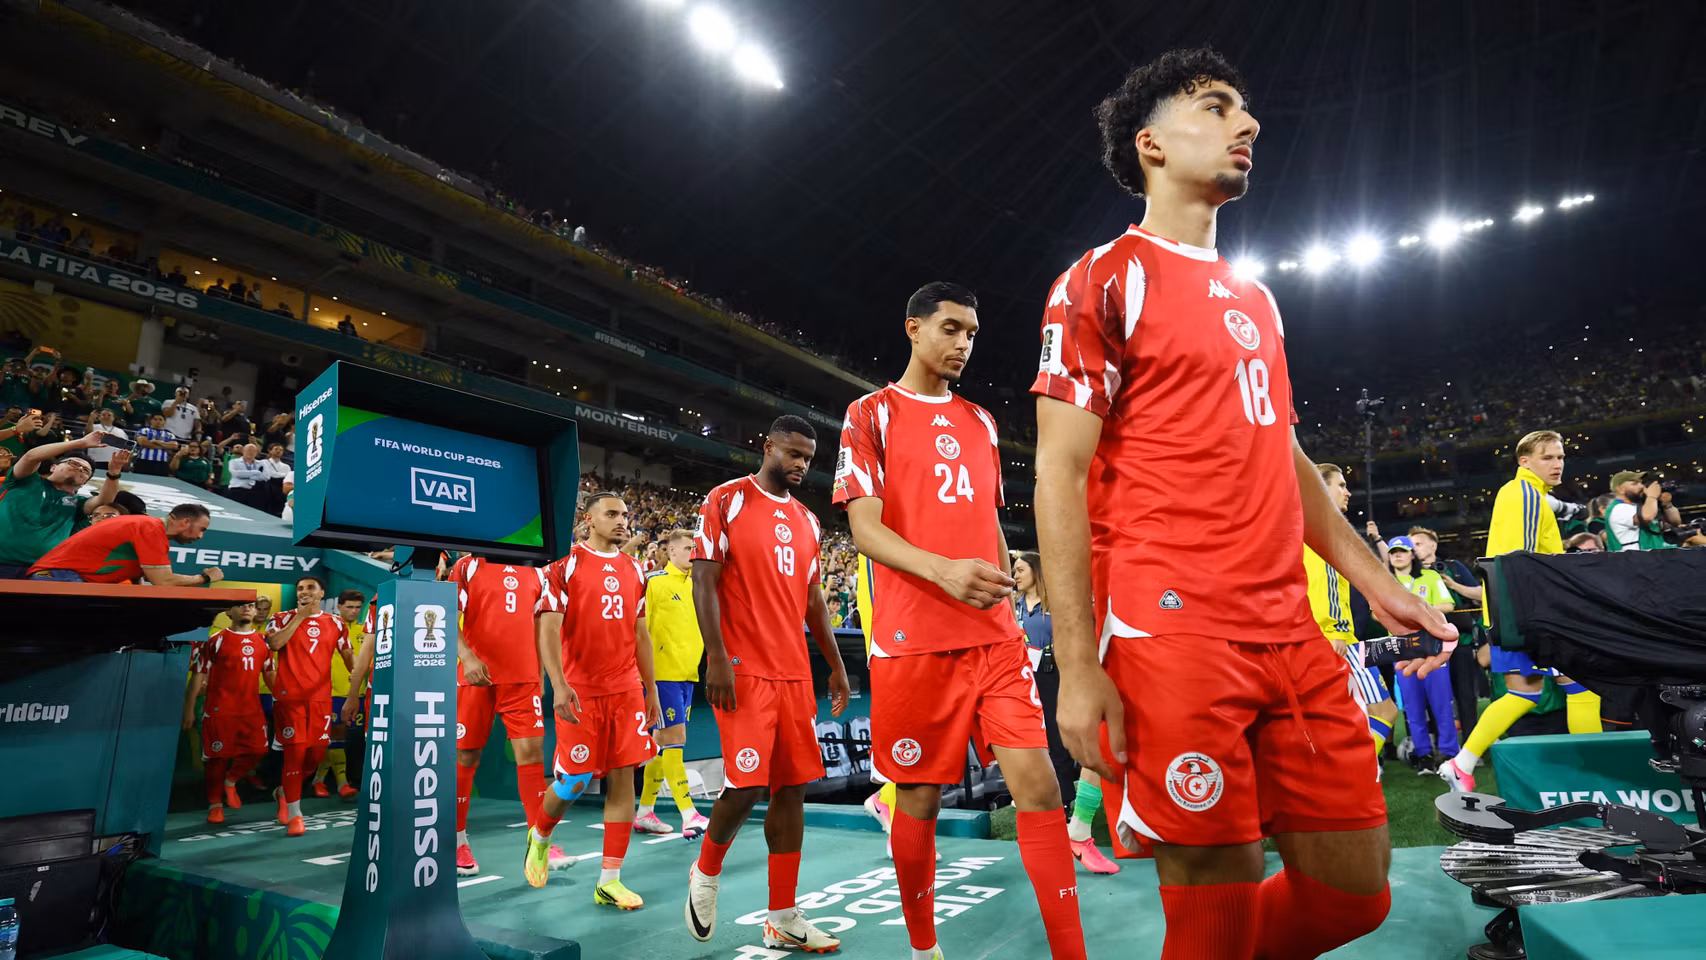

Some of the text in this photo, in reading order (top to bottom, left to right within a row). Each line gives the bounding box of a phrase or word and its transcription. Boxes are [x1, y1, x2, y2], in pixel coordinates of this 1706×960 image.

[39, 252, 100, 284] FIFA
[107, 273, 198, 309] 2026
[299, 387, 333, 421] Hisense
[1234, 358, 1276, 426] 18
[575, 405, 678, 442] MONTERREY
[374, 437, 501, 469] FIFA WORLD CUP 2026
[419, 478, 468, 502] VAR
[934, 463, 975, 503] 24
[169, 546, 320, 572] TERREY
[774, 545, 795, 576] 19
[505, 591, 517, 613] 9
[601, 595, 623, 619] 23
[309, 638, 319, 654] 7
[242, 656, 254, 670] 11
[375, 660, 392, 669] 2026
[413, 659, 446, 667] 2026
[533, 695, 543, 716] 9
[324, 715, 331, 731] 7
[366, 694, 389, 893] Hisense
[414, 691, 445, 888] Hisense
